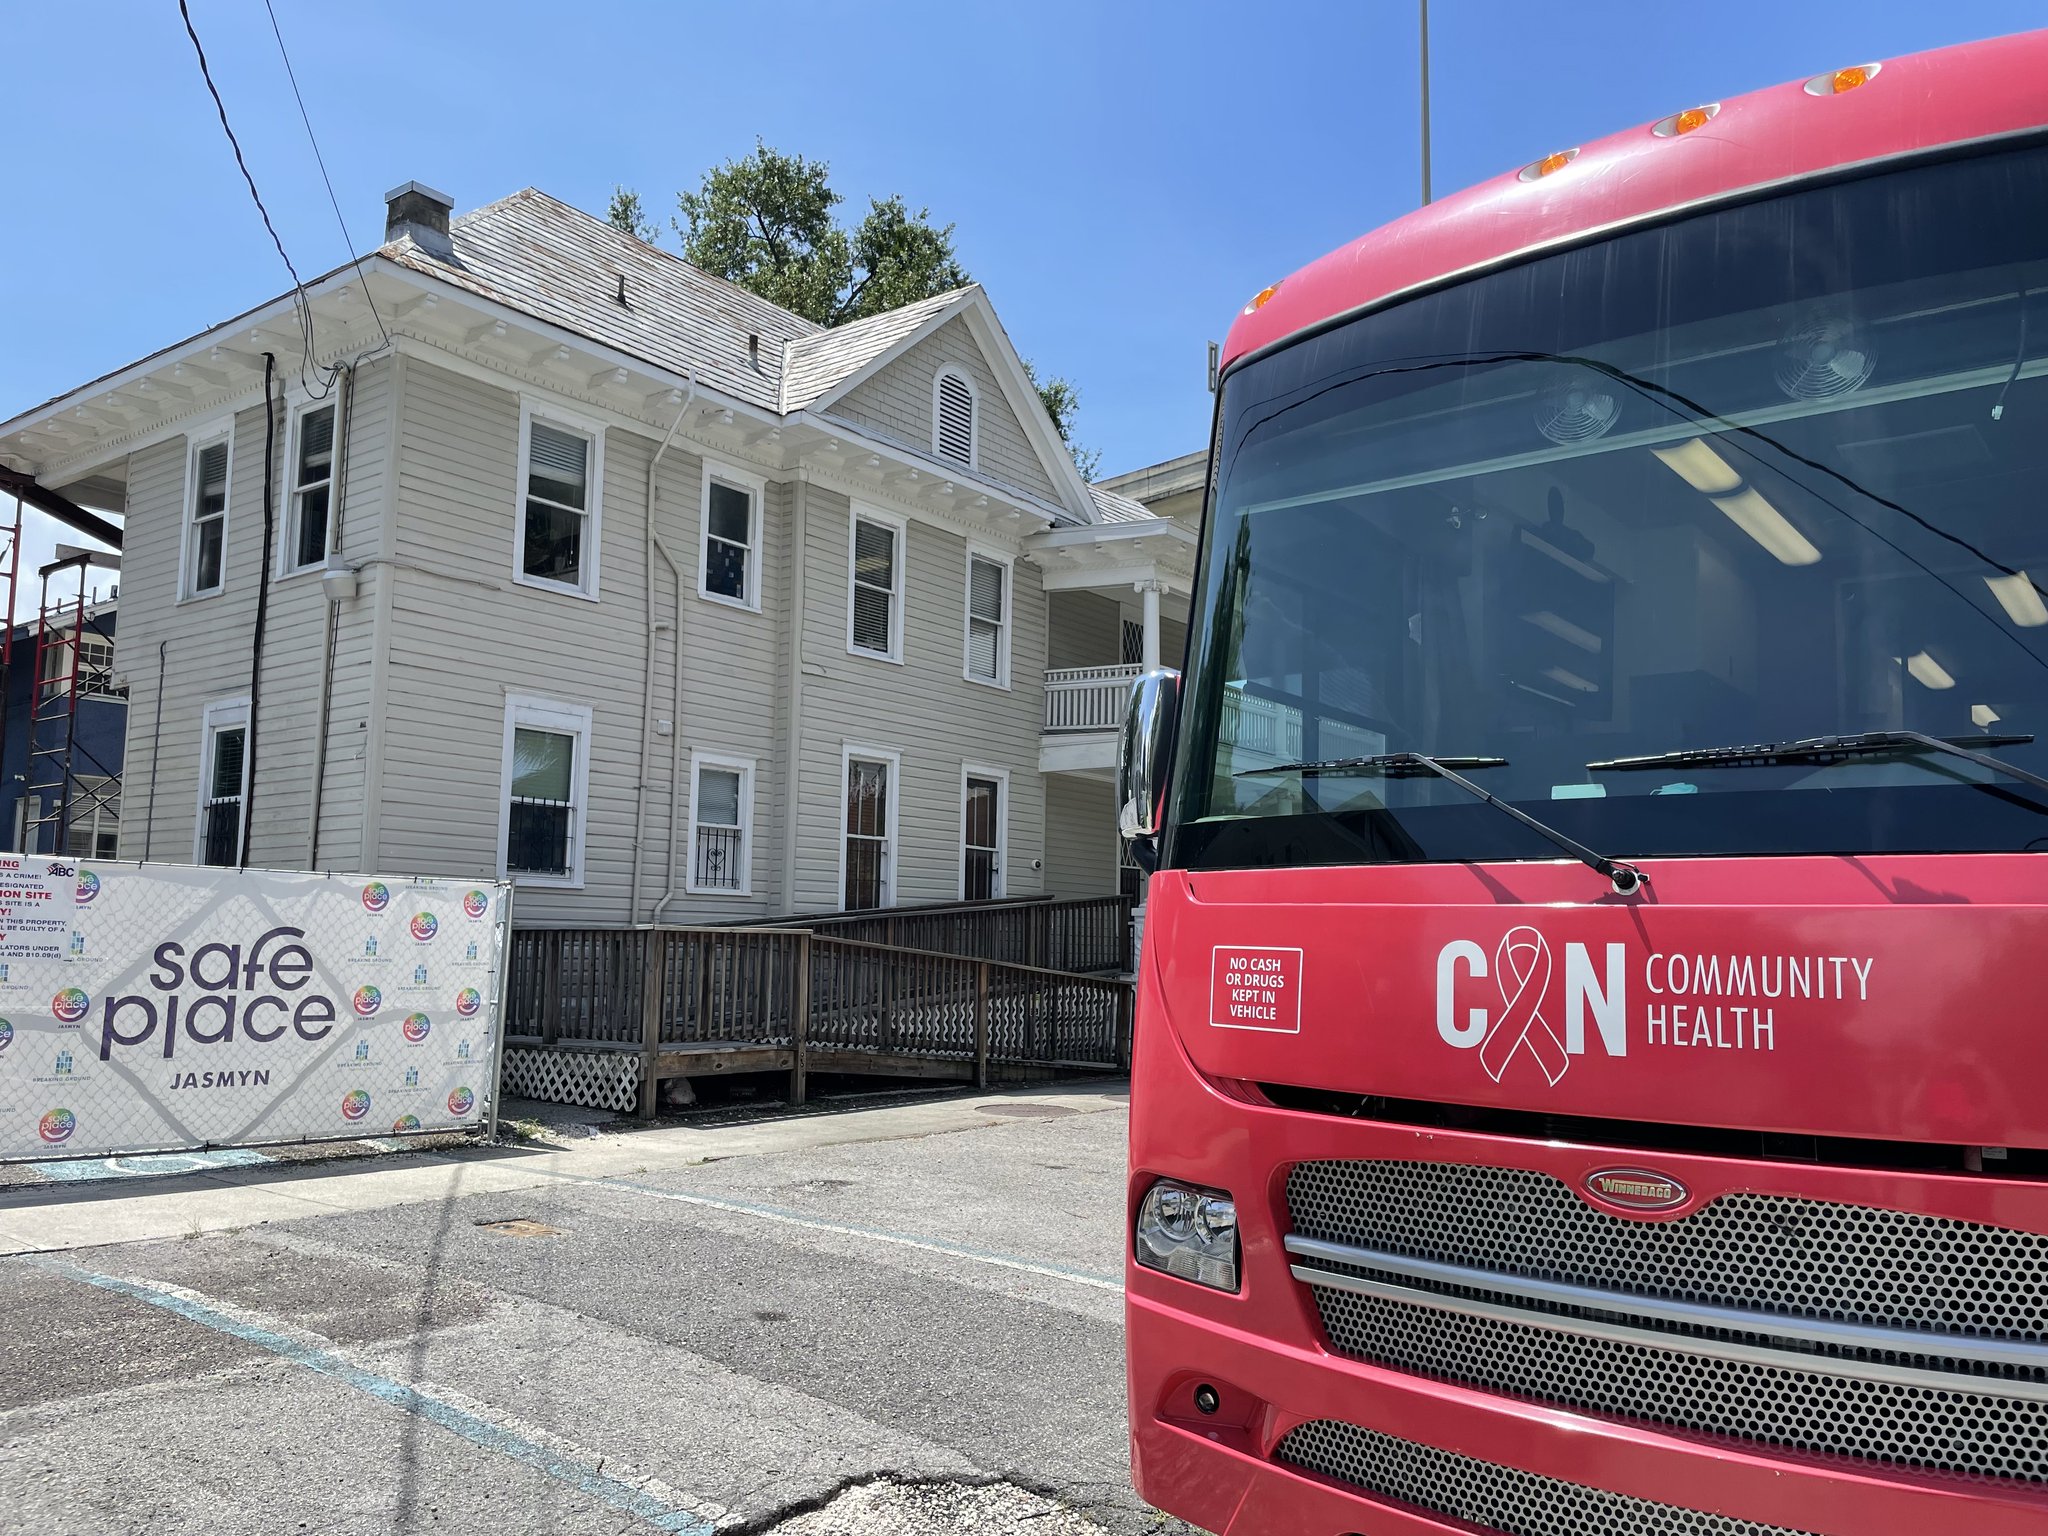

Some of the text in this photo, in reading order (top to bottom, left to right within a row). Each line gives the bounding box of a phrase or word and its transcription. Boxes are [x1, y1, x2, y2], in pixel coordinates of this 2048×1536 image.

[47, 866, 75, 878] ABC
[25, 891, 52, 900] SITE
[26, 919, 67, 927] PROPERTY,
[150, 927, 313, 991] safe
[1230, 957, 1281, 972] NO CASH
[1225, 973, 1284, 988] OR DRUGS
[1647, 953, 1874, 1001] COMMUNITY
[1232, 989, 1275, 1004] KEPT IN
[1230, 1004, 1276, 1020] VEHICLE
[100, 995, 335, 1061] place
[1648, 1004, 1774, 1051] HEALTH
[170, 1070, 270, 1090] JASMYN
